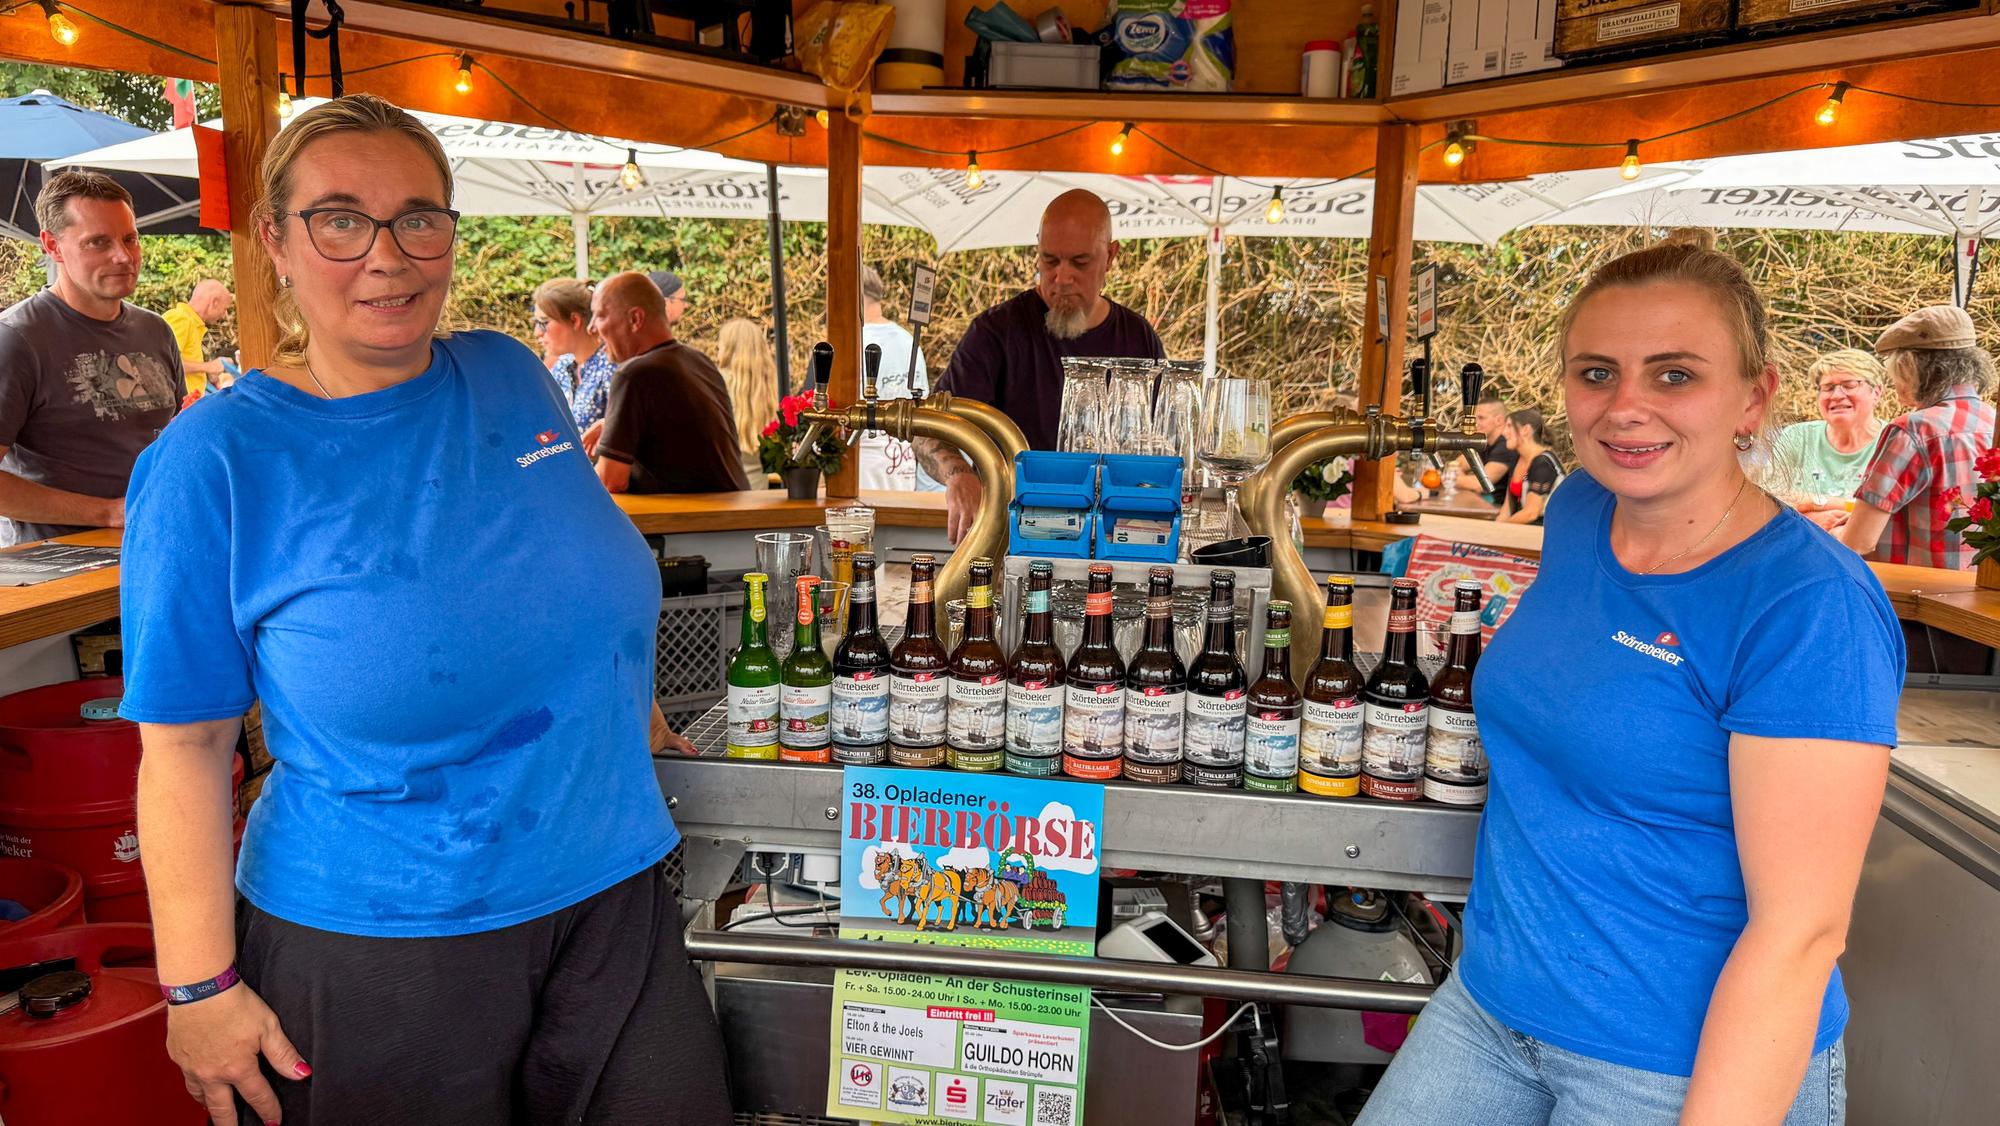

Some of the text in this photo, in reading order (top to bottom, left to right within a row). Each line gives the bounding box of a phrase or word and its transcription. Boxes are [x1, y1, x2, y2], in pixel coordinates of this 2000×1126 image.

[1601, 7, 1676, 29] BRAUSPEZIALITÄTEN
[1903, 136, 2000, 159] Stö
[1611, 630, 1685, 667] Störtebeker
[834, 679, 880, 691] Störtebeker
[893, 680, 940, 693] Störtebeker
[956, 684, 1003, 696] Störtebeker
[1072, 692, 1120, 705] Störtebeker
[1308, 706, 1360, 720] Störtebeker
[1375, 710, 1426, 724] Störtebeker
[1445, 715, 1476, 727] Störte
[1249, 720, 1287, 731] örtebeker
[852, 782, 986, 808] 38. Opladener
[849, 800, 1095, 860] BIERBÖRSE
[0, 842, 33, 858] beker
[945, 976, 962, 988] An
[967, 979, 989, 991] der
[992, 981, 1083, 1004] Schusterinsel
[845, 982, 856, 990] Fr.
[866, 984, 880, 993] Sa.
[938, 992, 954, 1002] Uhr
[963, 995, 977, 1005] So.
[988, 999, 1005, 1008] Mo.
[1064, 1007, 1081, 1017] Uhr
[930, 1007, 964, 1019] Eintritt
[965, 1010, 980, 1020] frei
[847, 1018, 924, 1038] Elton & the Joels
[845, 1041, 915, 1061] VIER GEWINNT
[964, 1041, 1074, 1073] GUILDO HORN
[978, 1064, 1019, 1075] Orthopädischen
[1019, 1069, 1043, 1078] Strümpfe
[986, 1093, 1025, 1109] Zipfer
